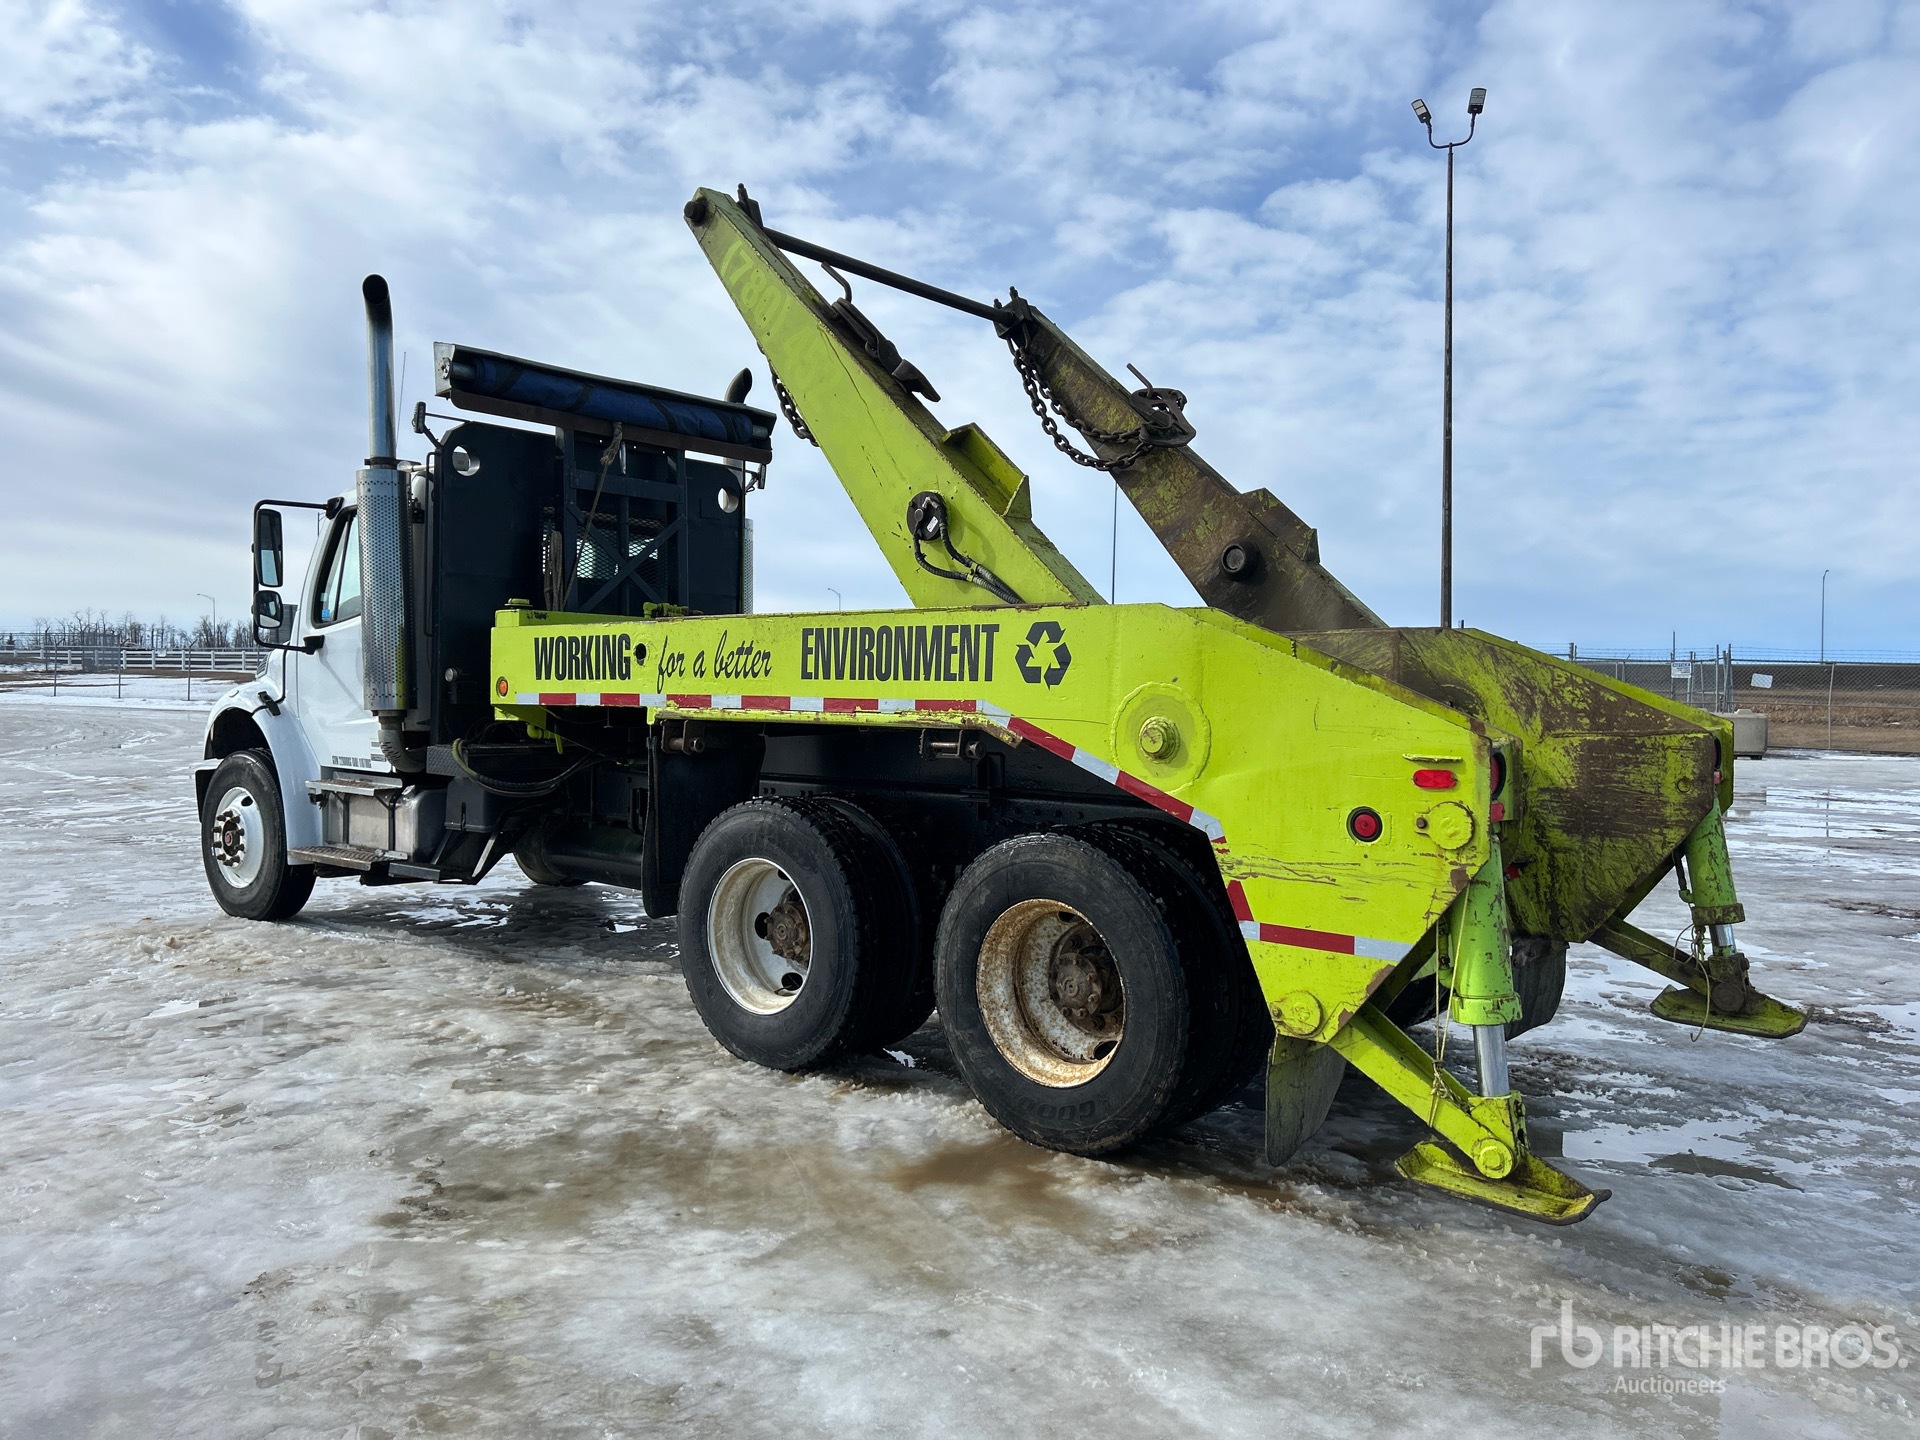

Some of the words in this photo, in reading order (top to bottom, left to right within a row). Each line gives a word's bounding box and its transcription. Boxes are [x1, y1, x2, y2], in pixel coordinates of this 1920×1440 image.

[534, 633, 631, 681] WORKING
[657, 635, 686, 694] for
[692, 649, 706, 678] a
[714, 629, 773, 679] better
[801, 623, 999, 682] ENVIRONMENT
